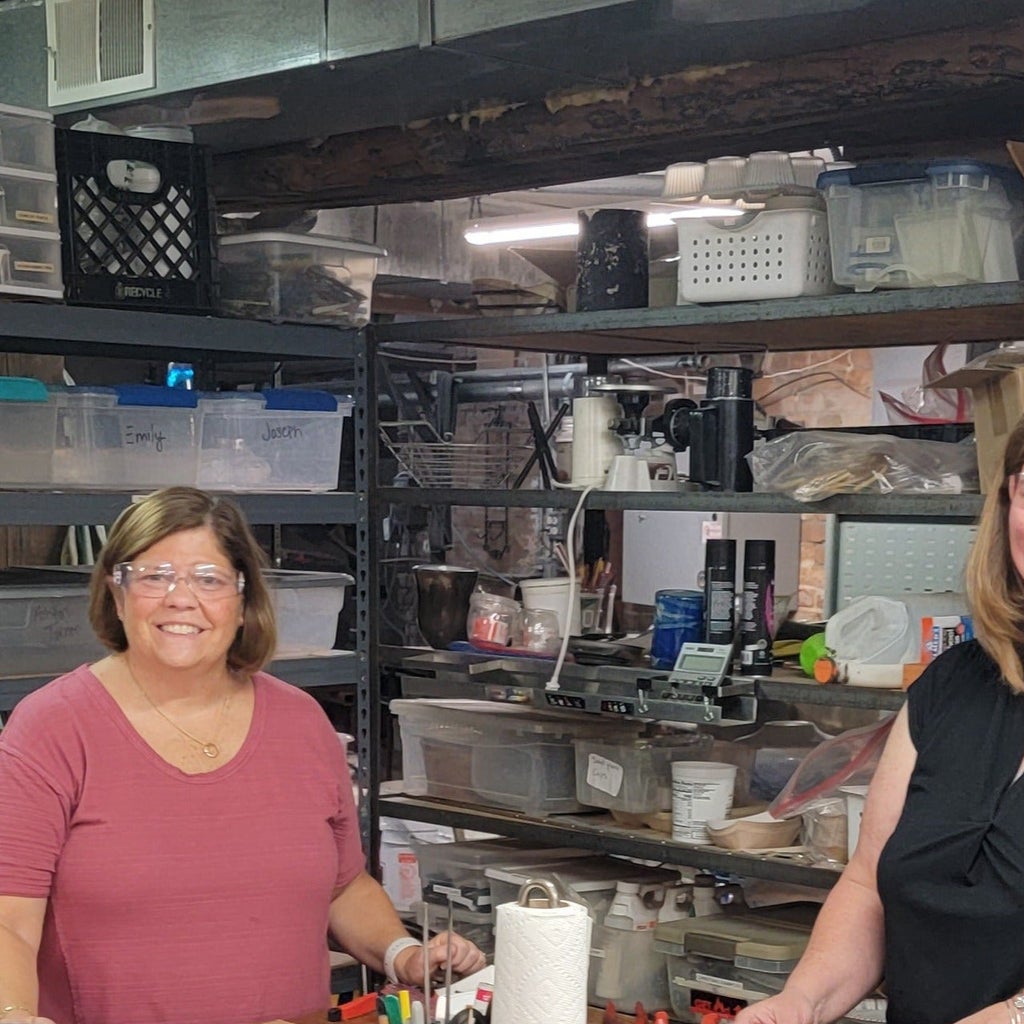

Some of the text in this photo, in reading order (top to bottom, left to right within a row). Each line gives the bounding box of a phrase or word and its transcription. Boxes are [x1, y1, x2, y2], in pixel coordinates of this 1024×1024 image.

[123, 286, 163, 299] RECYCLE
[126, 424, 167, 451] Emily
[261, 422, 303, 443] Joseph
